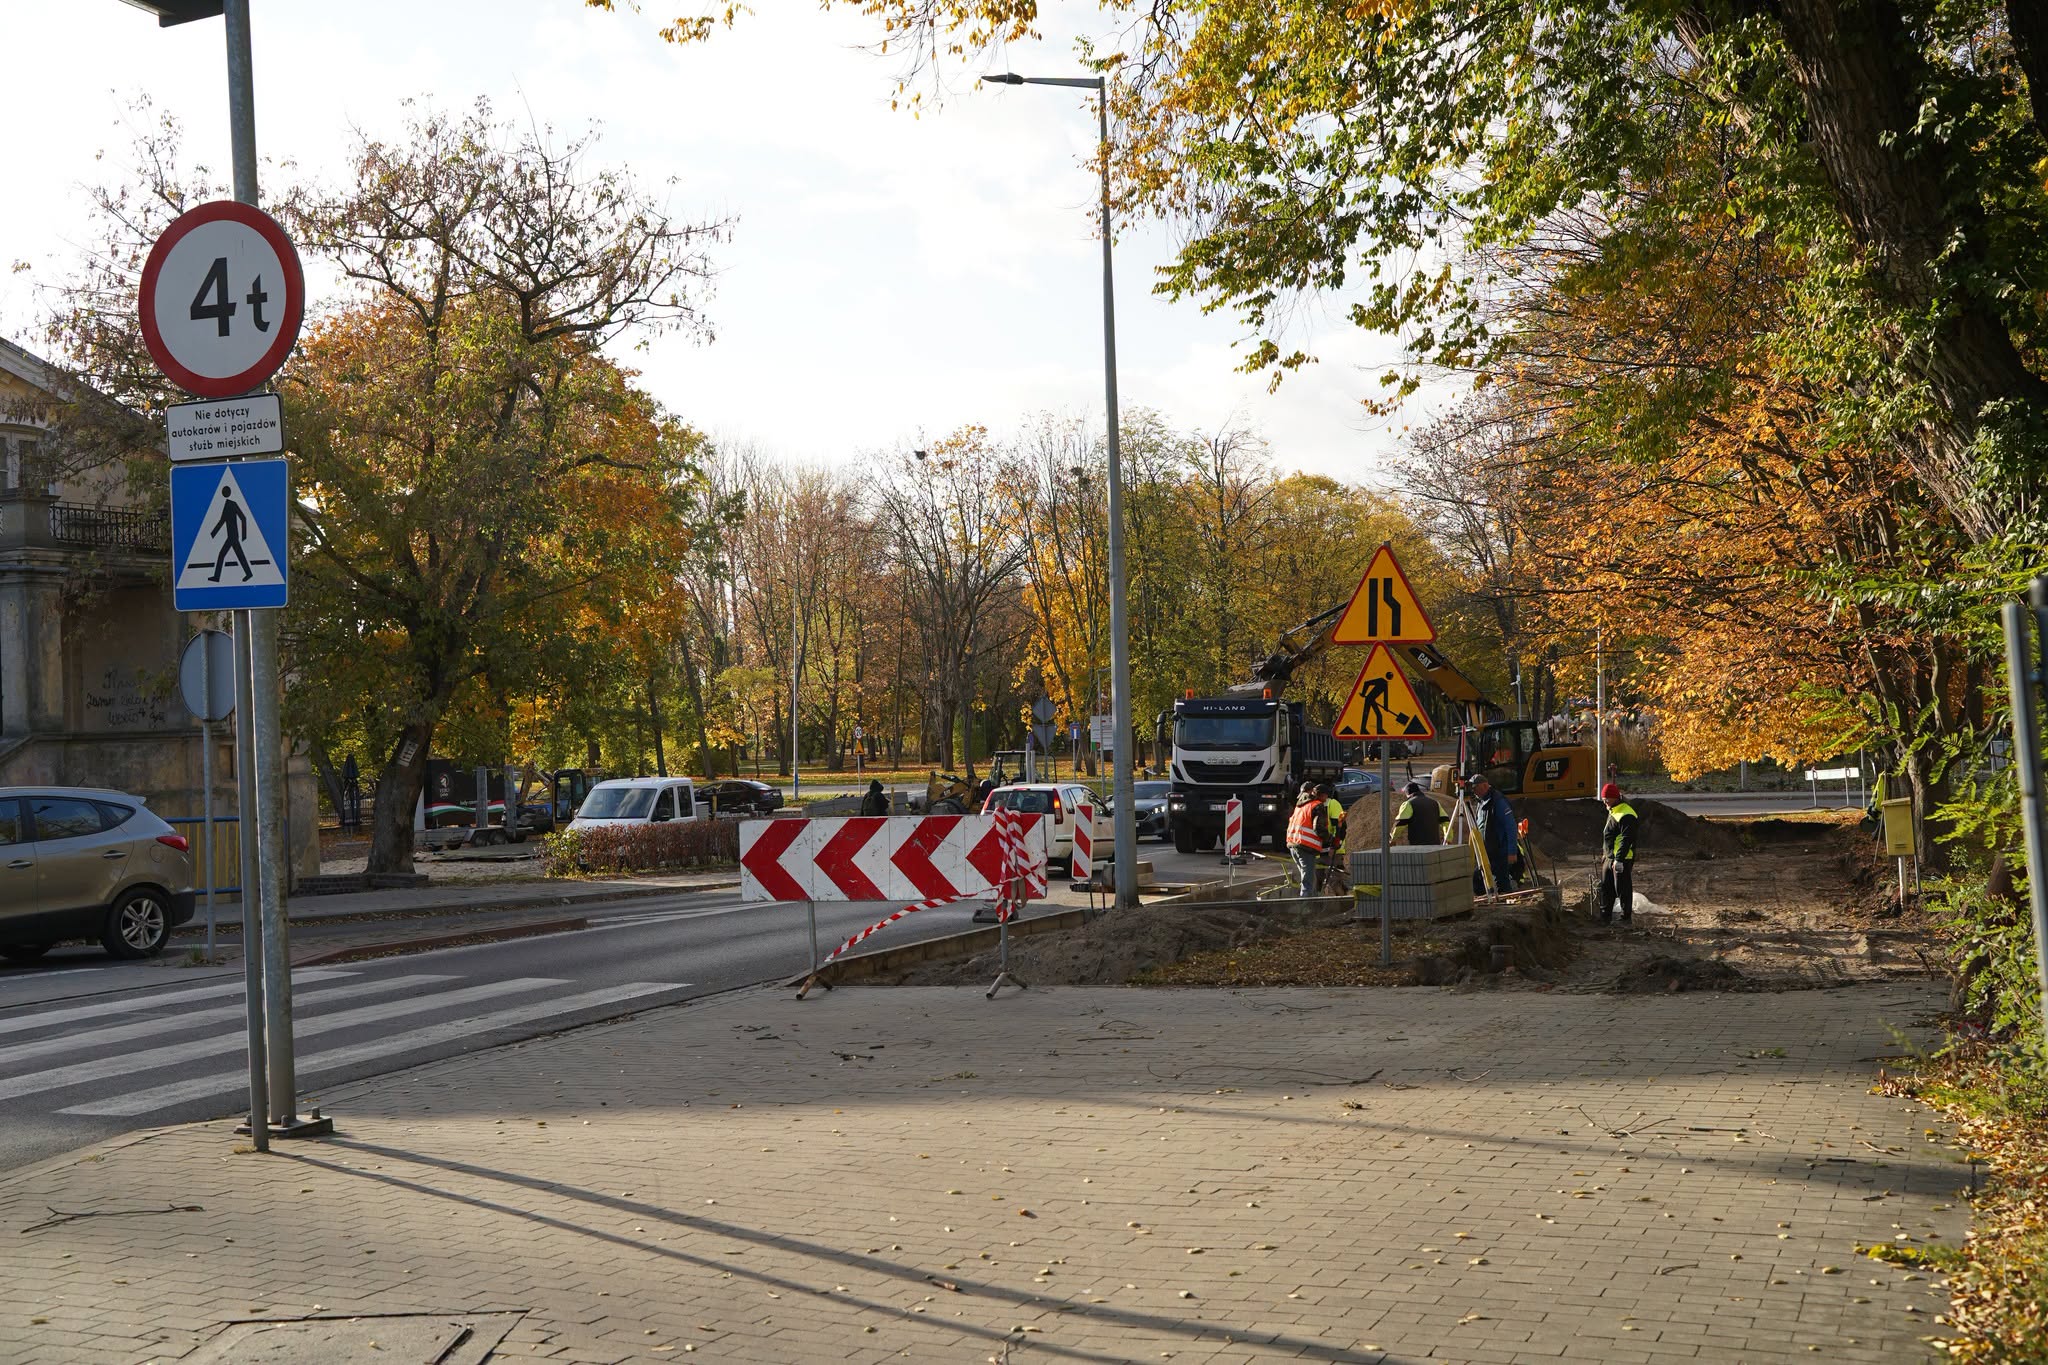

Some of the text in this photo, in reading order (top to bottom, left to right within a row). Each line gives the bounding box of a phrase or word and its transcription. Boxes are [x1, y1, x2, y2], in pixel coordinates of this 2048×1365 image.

[195, 407, 250, 420] Nie dotyczy
[171, 418, 277, 438] autokarów i pojazdów
[189, 435, 261, 452] służb miejskich
[1417, 652, 1433, 668] CAT
[1545, 761, 1560, 772] CAT
